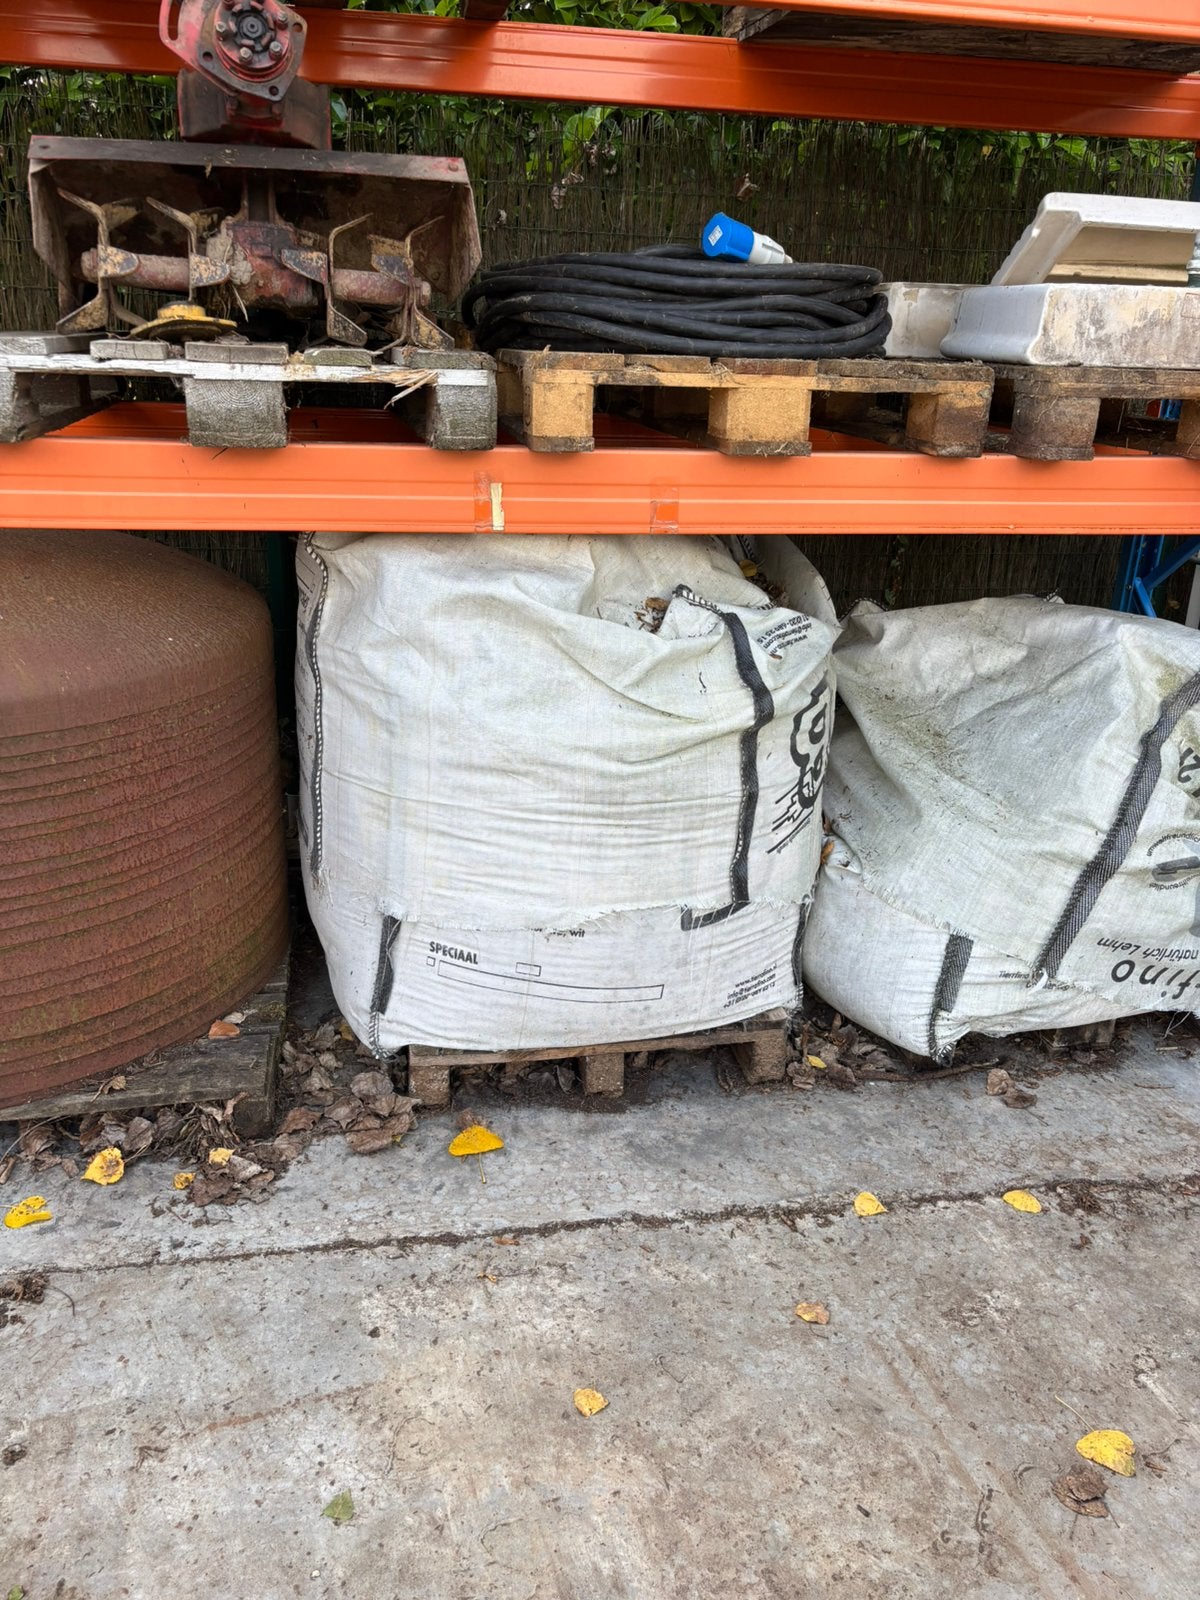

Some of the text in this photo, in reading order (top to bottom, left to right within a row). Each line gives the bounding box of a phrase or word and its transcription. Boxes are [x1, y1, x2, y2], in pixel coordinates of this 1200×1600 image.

[429, 940, 479, 965] SPECIAAL
[1096, 937, 1199, 962] natürlich Lehm
[1110, 959, 1200, 1000] fino
